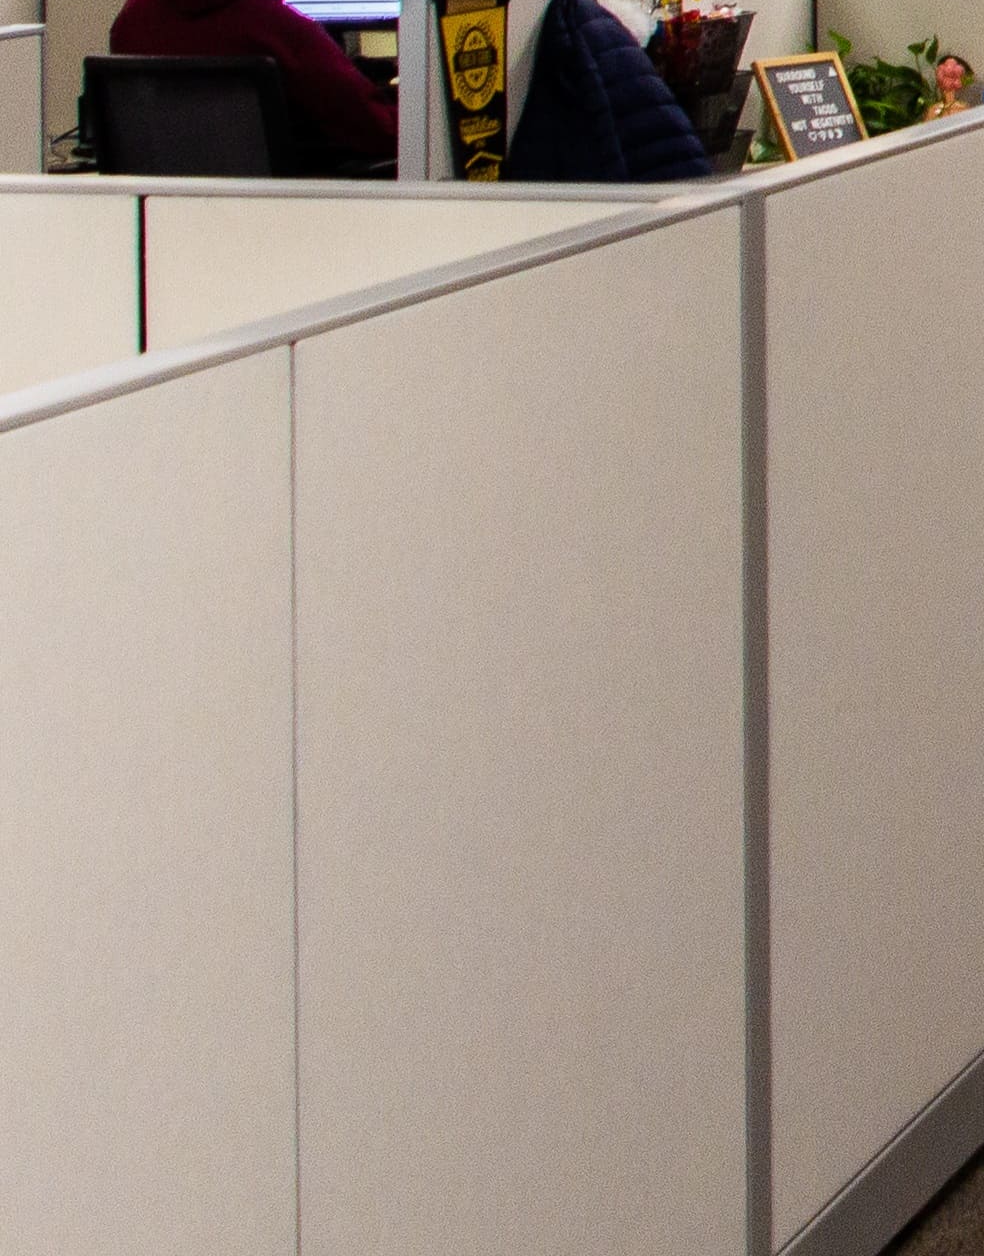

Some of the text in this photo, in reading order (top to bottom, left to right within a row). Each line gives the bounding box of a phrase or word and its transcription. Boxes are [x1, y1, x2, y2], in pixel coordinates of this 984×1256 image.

[775, 68, 816, 84] SURROUND
[788, 79, 825, 95] YOURSELF
[801, 93, 824, 105] WITH
[791, 119, 808, 132] NOT
